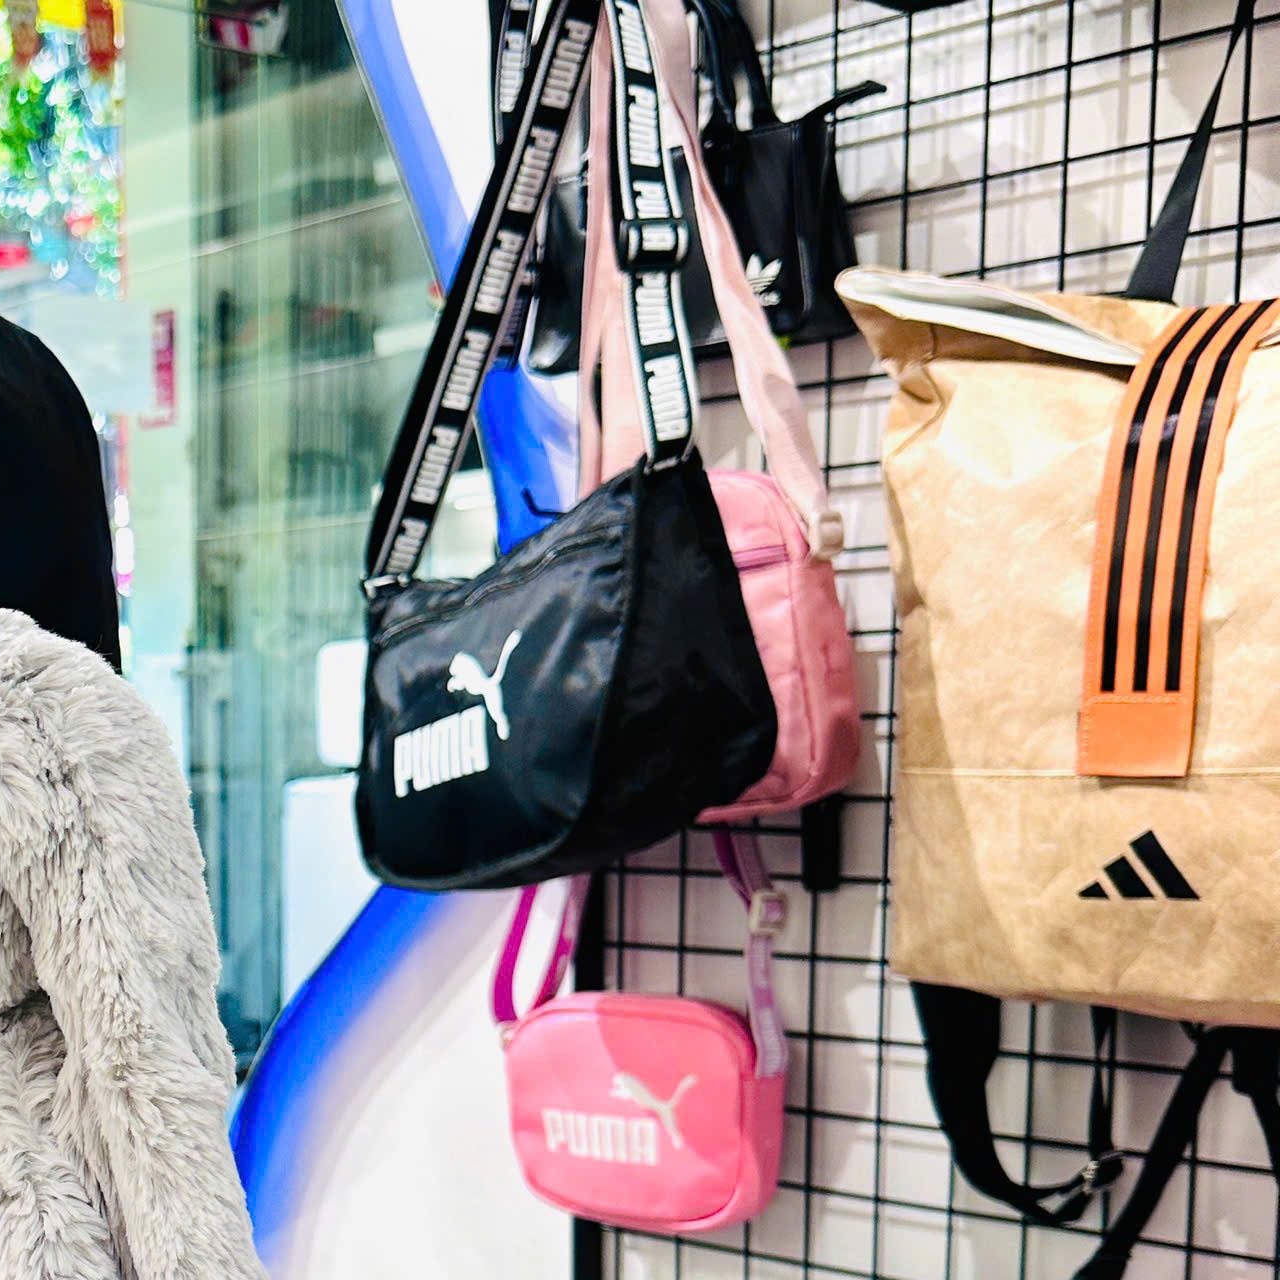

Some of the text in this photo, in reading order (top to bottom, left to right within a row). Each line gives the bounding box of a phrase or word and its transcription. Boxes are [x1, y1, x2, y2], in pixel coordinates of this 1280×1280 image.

[540, 19, 594, 110] PUMA
[615, 0, 652, 74] PUMA
[627, 84, 661, 168] PUMA
[506, 126, 560, 214] PUMA
[474, 229, 524, 315] PUMA
[636, 271, 676, 346] PUMA
[441, 329, 492, 410] PUMA
[644, 352, 690, 442] PUMA
[411, 426, 460, 505] PUMA
[385, 518, 427, 573] PUM
[393, 704, 490, 799] PUMA
[541, 1108, 662, 1167] PUMA
